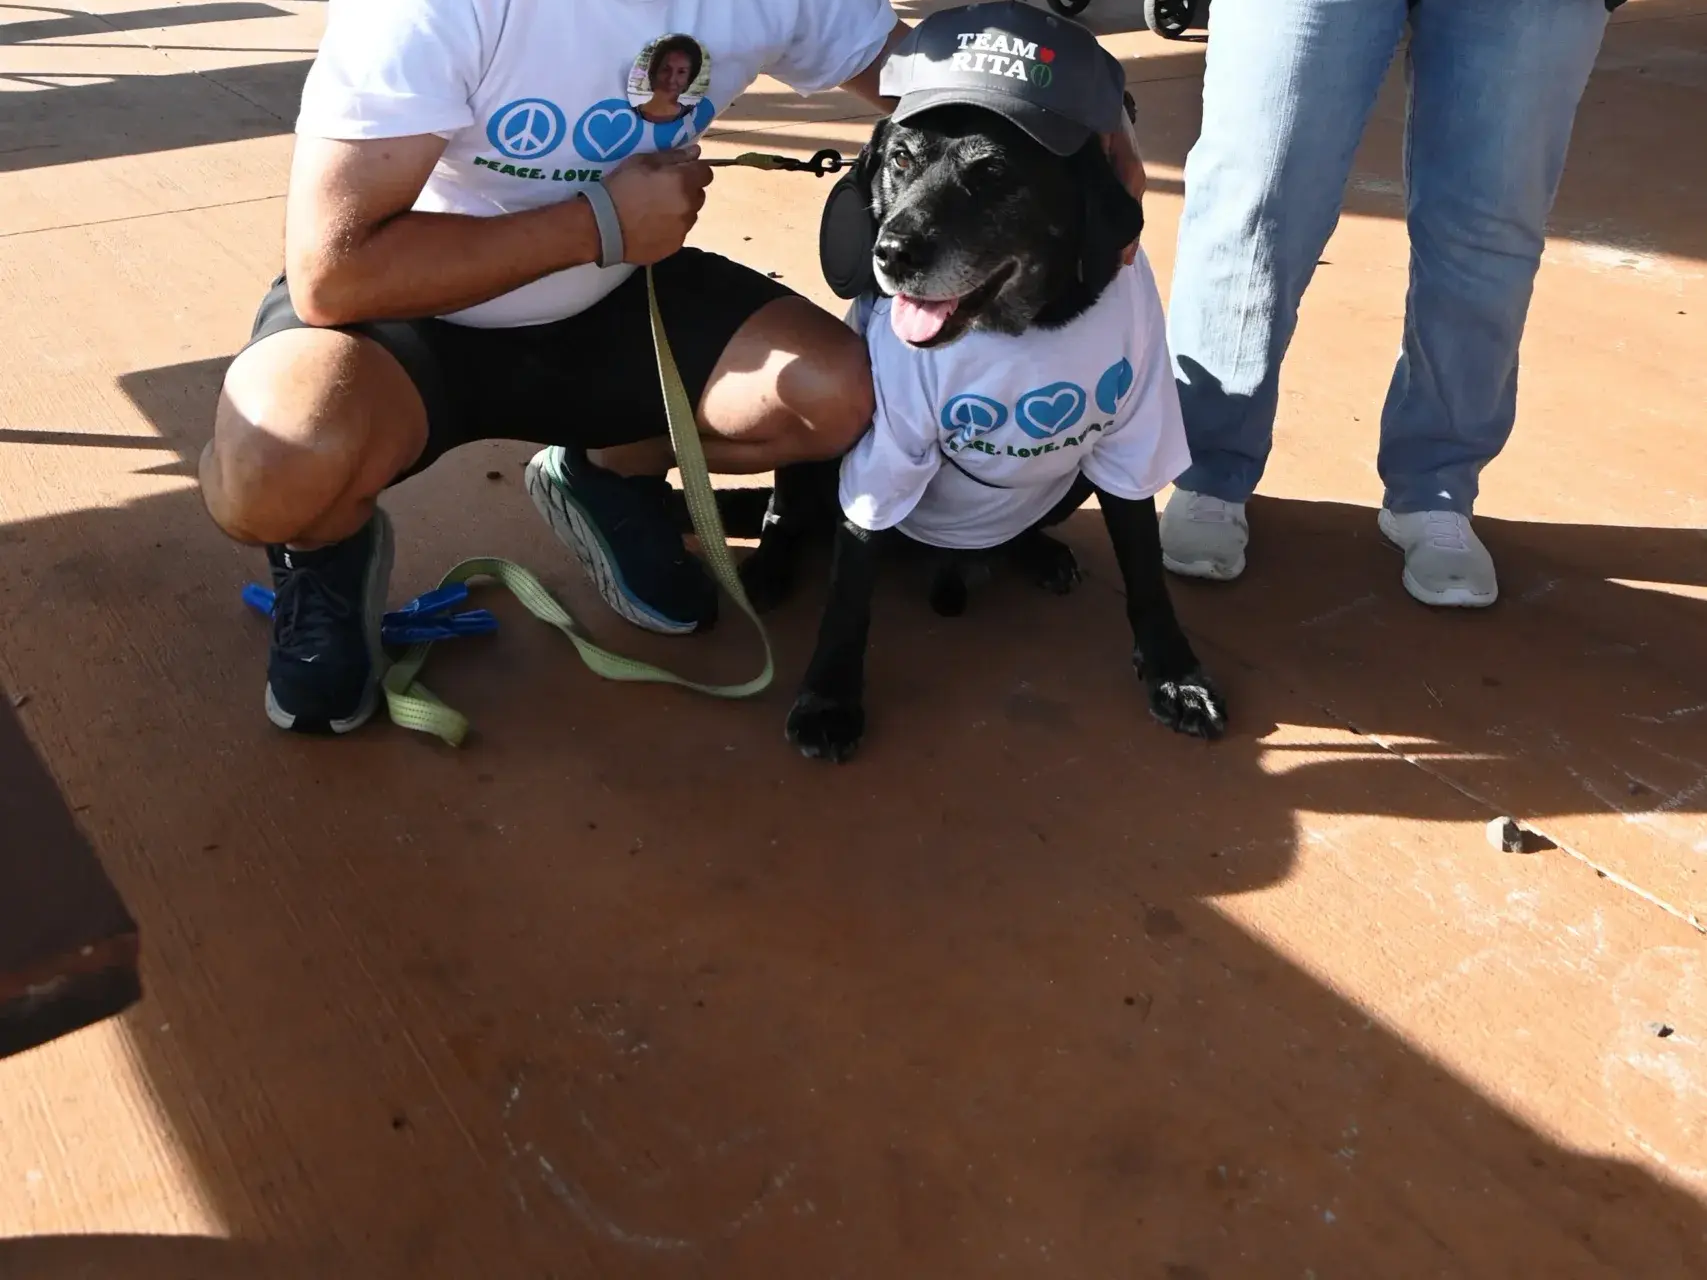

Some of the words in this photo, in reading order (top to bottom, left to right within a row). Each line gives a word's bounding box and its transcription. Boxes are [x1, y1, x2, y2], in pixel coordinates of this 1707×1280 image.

[956, 32, 1039, 60] TEAM
[949, 52, 1028, 82] RITA
[473, 156, 546, 180] PEACE.
[1007, 442, 1061, 458] LOVE.
